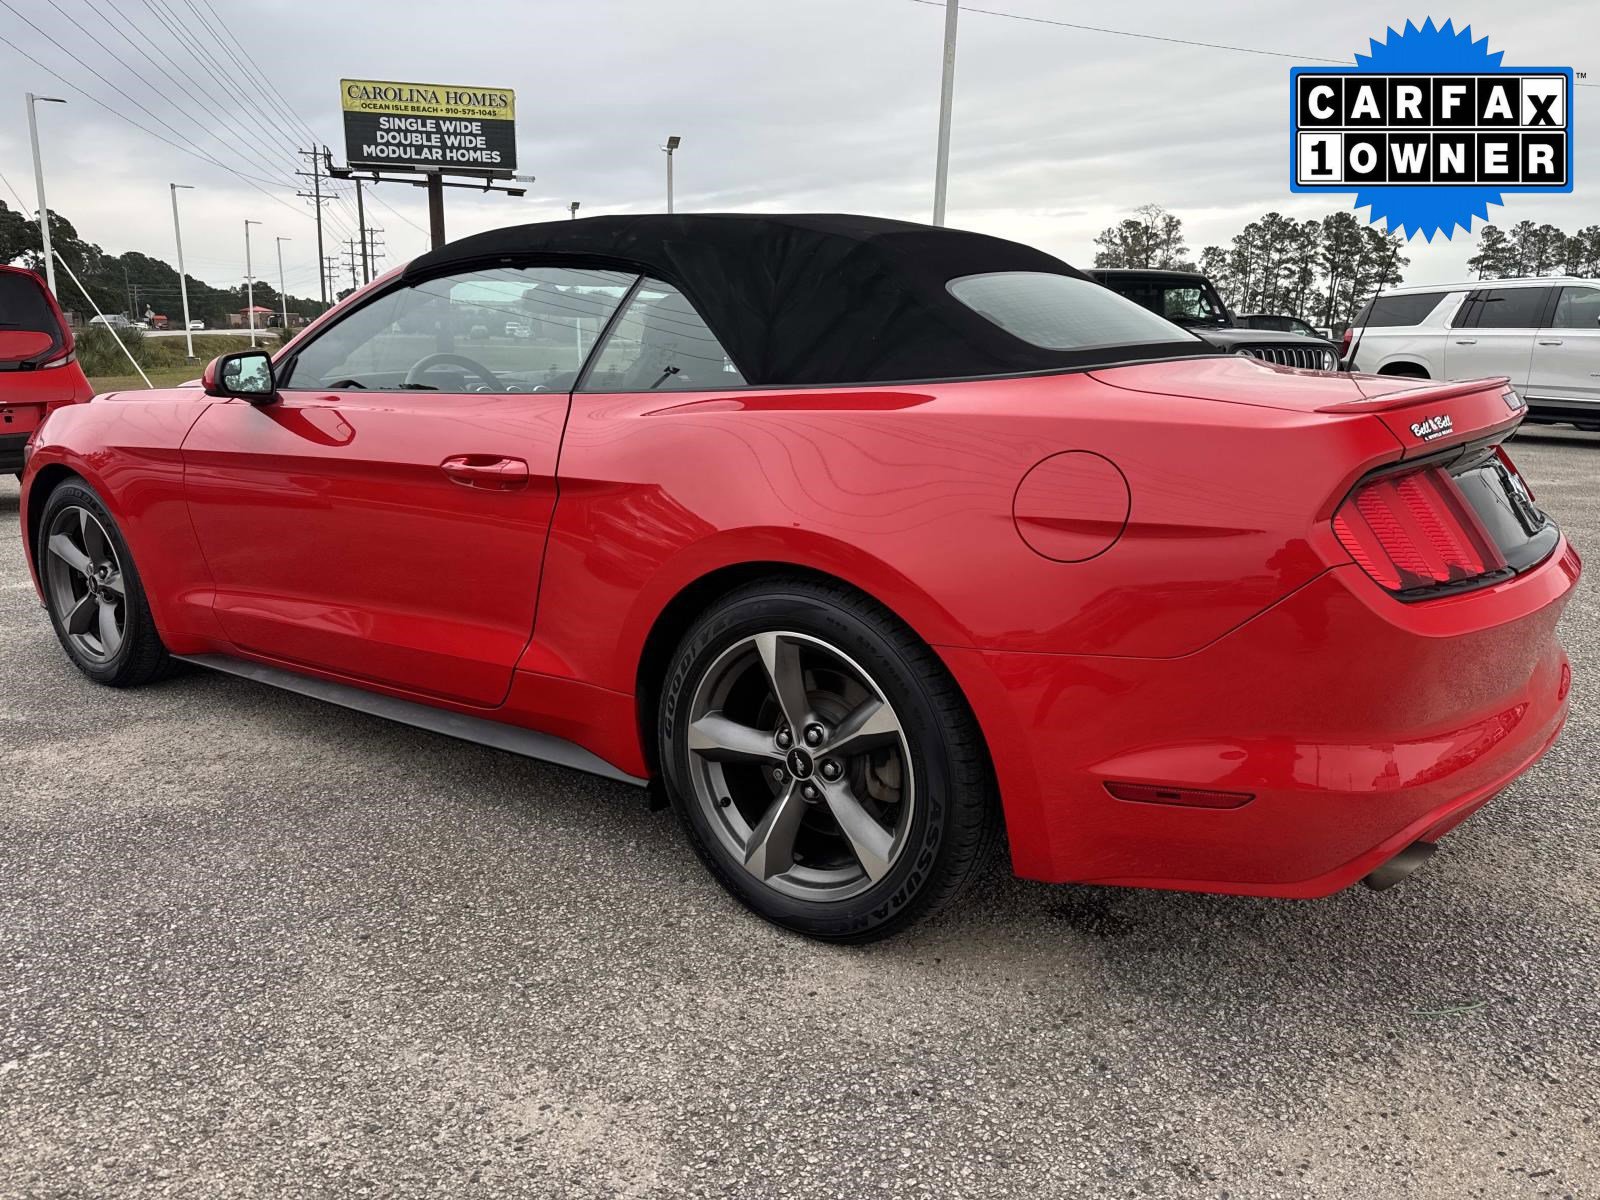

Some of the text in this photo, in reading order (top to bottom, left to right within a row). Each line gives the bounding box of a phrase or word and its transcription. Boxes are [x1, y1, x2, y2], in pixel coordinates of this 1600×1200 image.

[347, 84, 508, 108] CAROLINA HOMES
[361, 103, 497, 117] OCEAN ISLE BEACH 910-575-1045
[379, 117, 482, 134] SINGLE WIDE
[376, 131, 487, 149] DOUBLE WIDE
[362, 144, 501, 163] MODULAR HOMES
[1411, 421, 1431, 436] Bell
[1434, 415, 1452, 428] Bell
